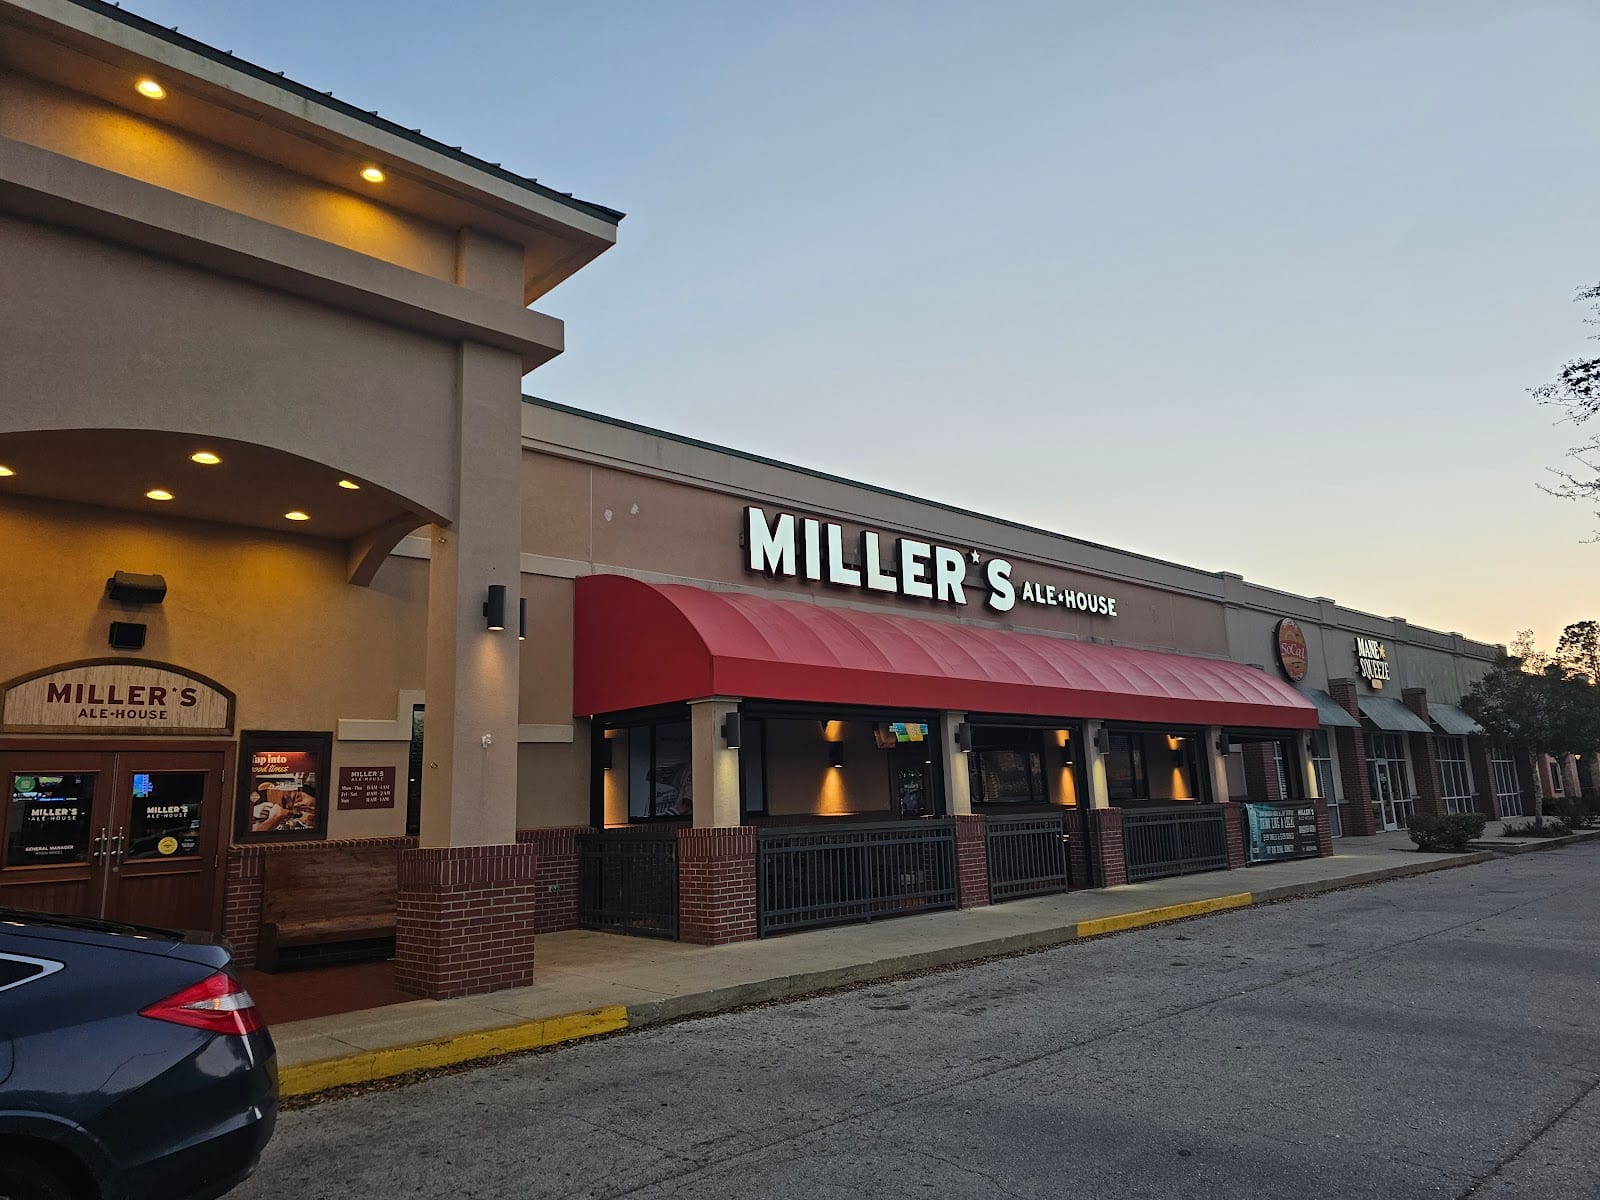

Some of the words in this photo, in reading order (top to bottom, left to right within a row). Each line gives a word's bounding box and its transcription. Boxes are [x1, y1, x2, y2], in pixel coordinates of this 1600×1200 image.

[746, 506, 1016, 612] MILLER'S
[1360, 658, 1391, 680] SQUEEZE
[46, 682, 198, 708] MILLER'S
[267, 754, 287, 764] into
[351, 770, 385, 778] MILLER'S
[31, 808, 78, 816] MILLER'S
[146, 806, 189, 814] MILLER'S
